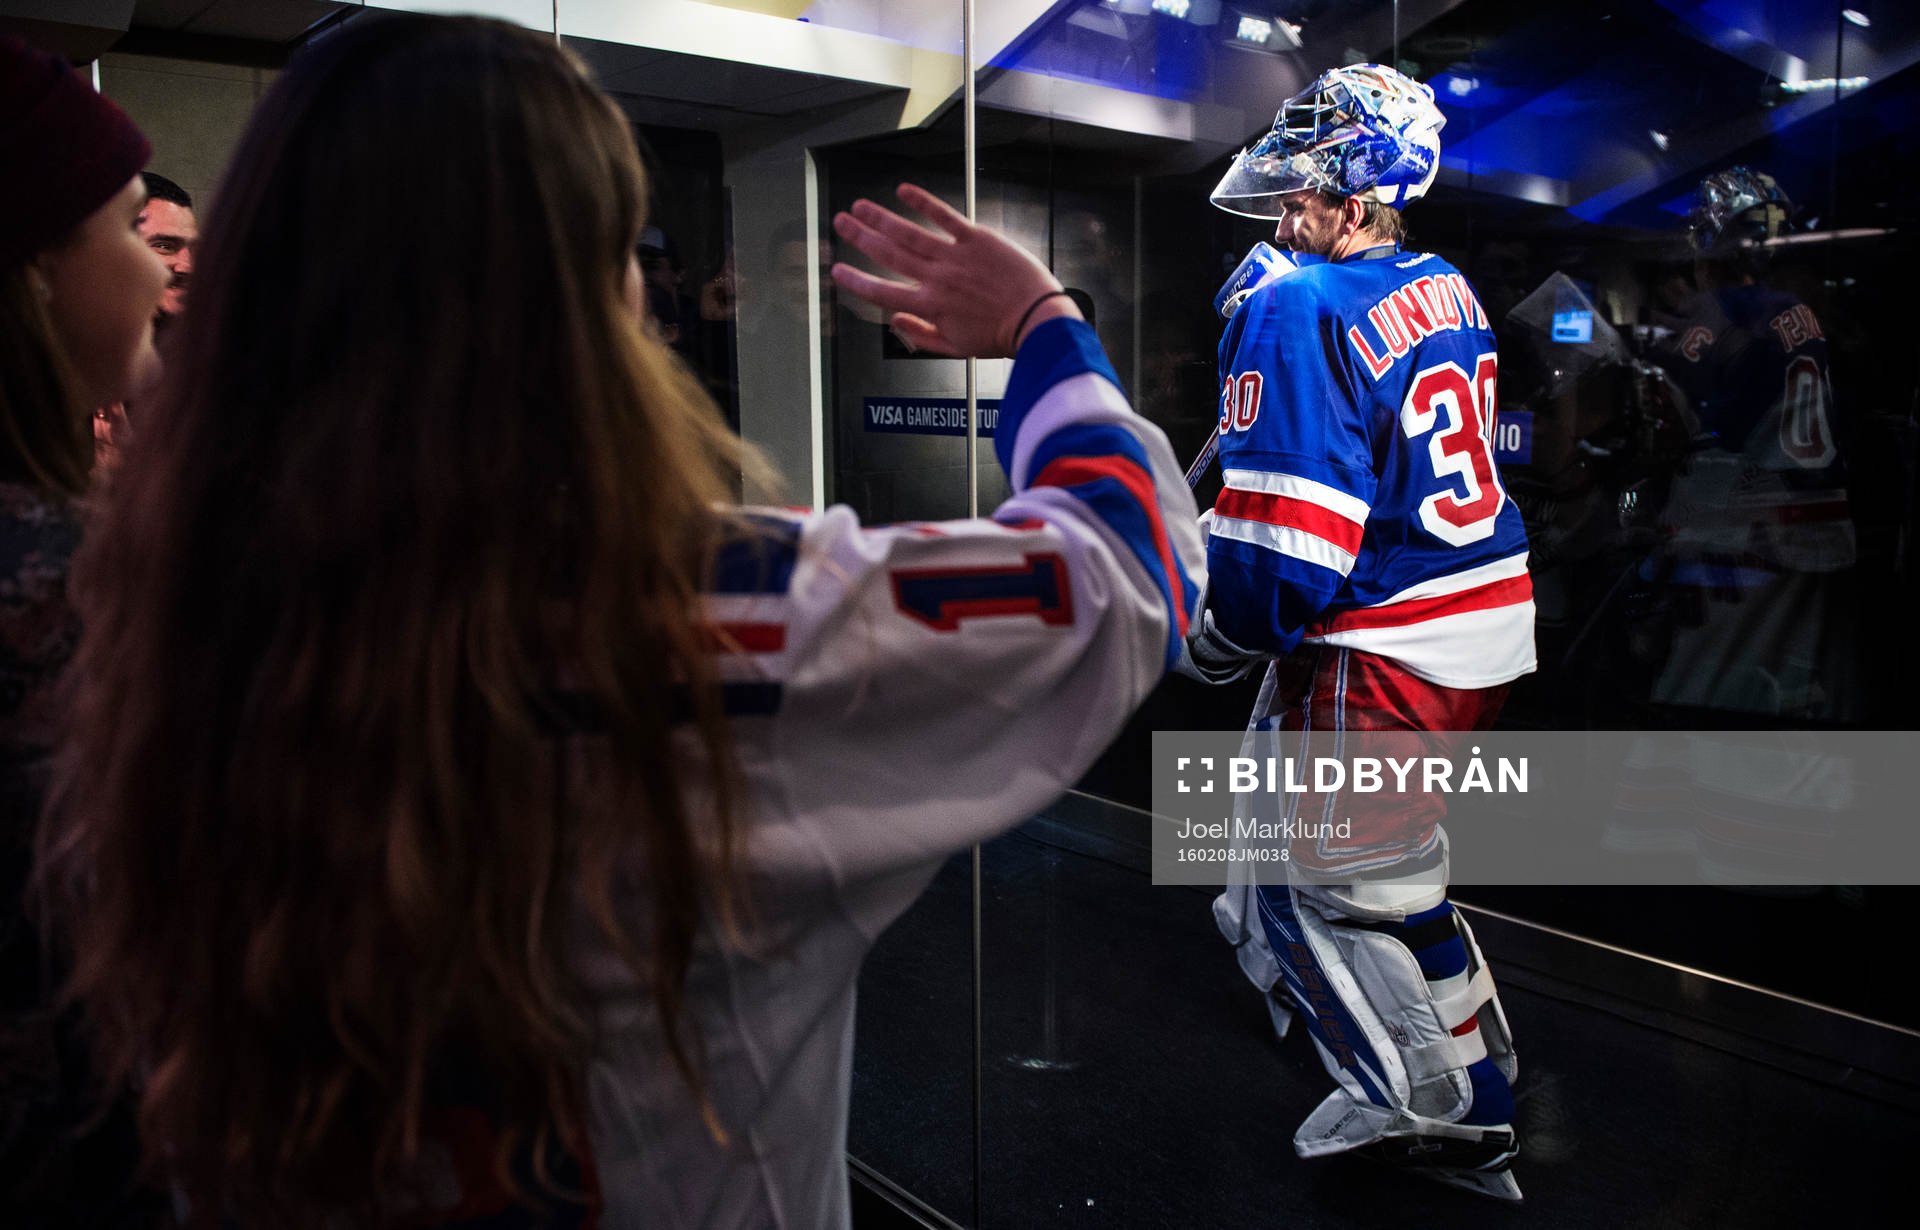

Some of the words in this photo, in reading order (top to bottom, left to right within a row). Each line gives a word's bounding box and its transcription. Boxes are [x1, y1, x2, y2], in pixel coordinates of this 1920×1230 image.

[868, 405, 904, 425] VISA
[906, 406, 967, 428] GAMESIDE
[975, 409, 1000, 429] TUD
[1218, 371, 1264, 435] 30
[1400, 352, 1506, 547] 30
